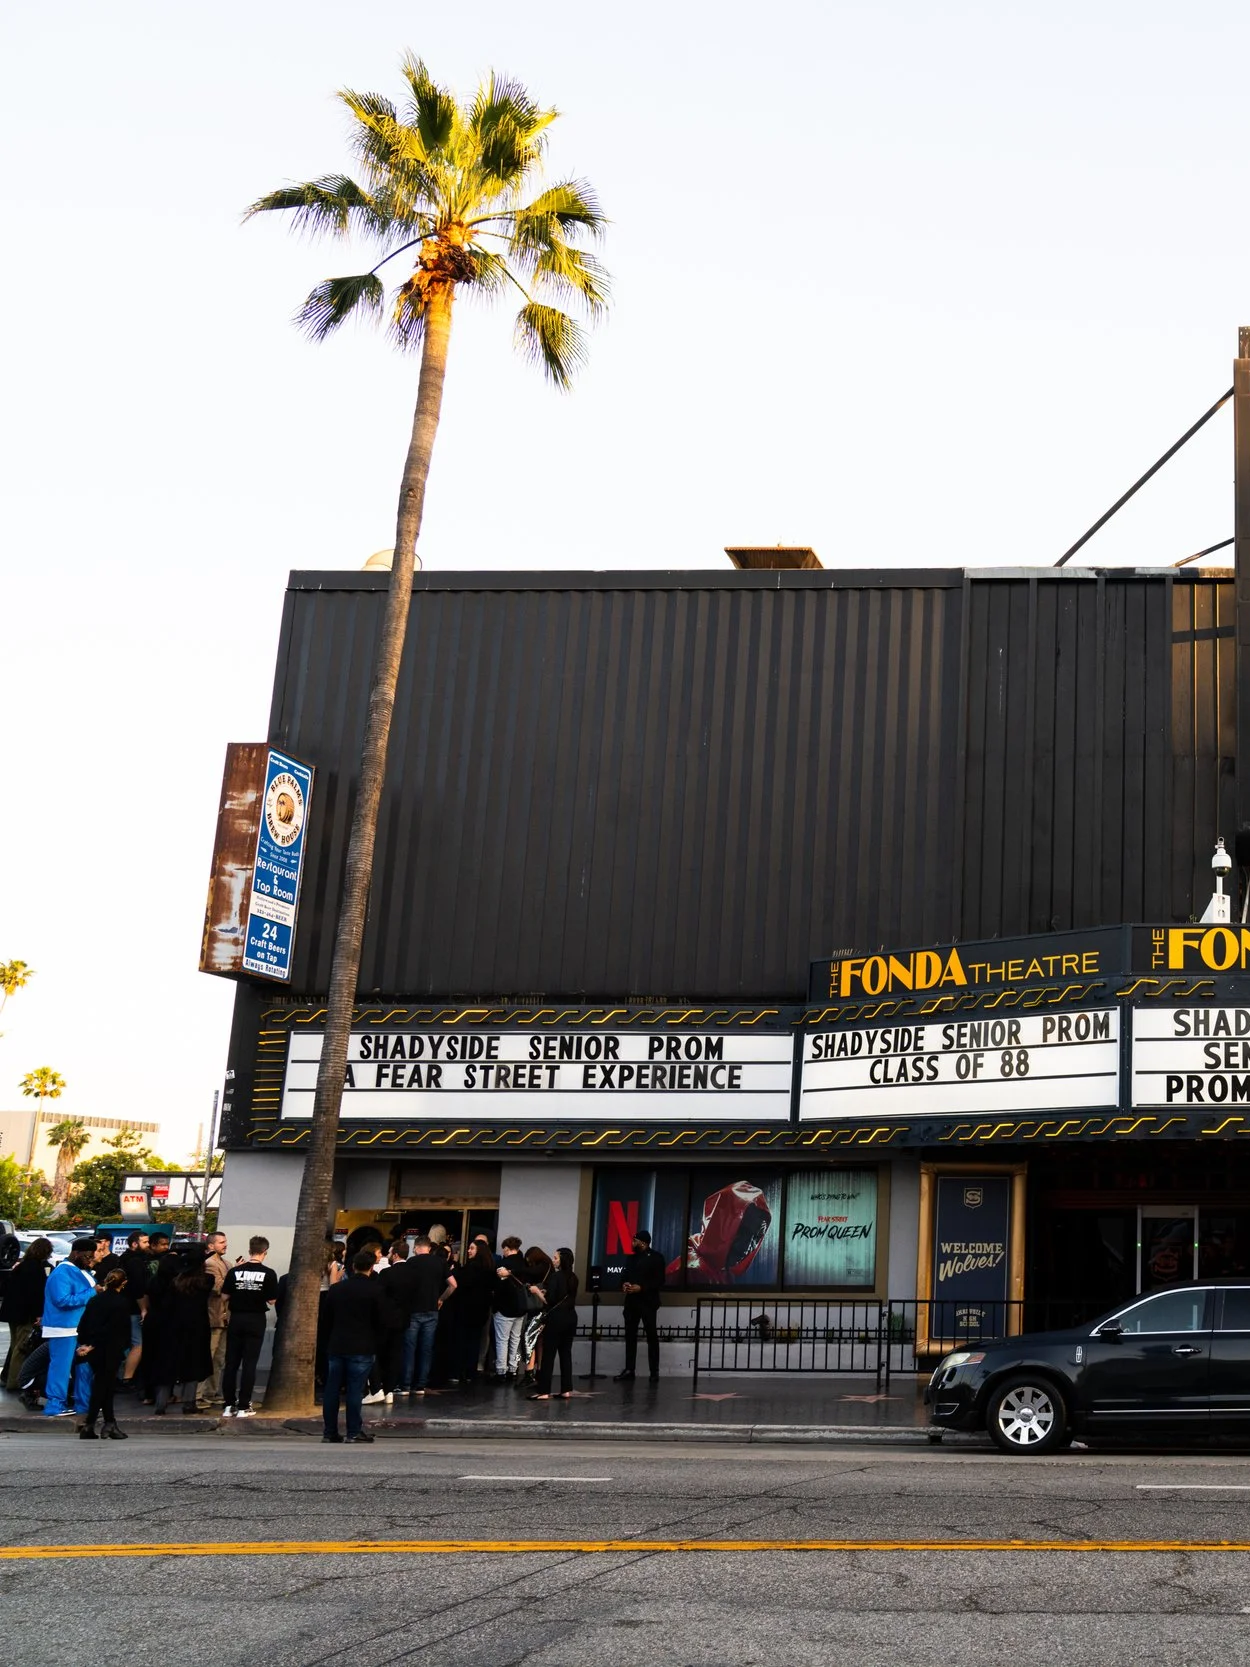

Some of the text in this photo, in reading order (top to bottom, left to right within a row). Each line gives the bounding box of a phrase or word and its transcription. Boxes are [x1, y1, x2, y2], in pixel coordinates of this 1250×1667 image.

[271, 775, 286, 792] BLUE
[267, 813, 300, 844] BREW HOUSE
[257, 857, 297, 881] Restaurant
[274, 875, 278, 885] &
[256, 879, 294, 902] Tap Room
[262, 923, 278, 940] 24
[250, 936, 286, 954] Craft Beers
[1152, 928, 1164, 969] THE
[246, 958, 286, 978] Always Rotating
[266, 952, 278, 964] Tap
[830, 960, 840, 998] THE
[840, 947, 1100, 998] FONDA THEATRE
[360, 1035, 724, 1060] SHADYSIDE SENIOR PROM
[812, 1012, 1110, 1060] SHADYSIDE SENIOR PROM
[375, 1064, 442, 1088] FEAR
[464, 1064, 560, 1088] STREET
[582, 1064, 742, 1089] EXPERIENCE
[869, 1049, 1030, 1084] CLASS OF 88
[792, 1220, 874, 1240] PROM QUEEN
[940, 1242, 1003, 1254] WELCOME
[938, 1252, 1005, 1282] Wolves!
